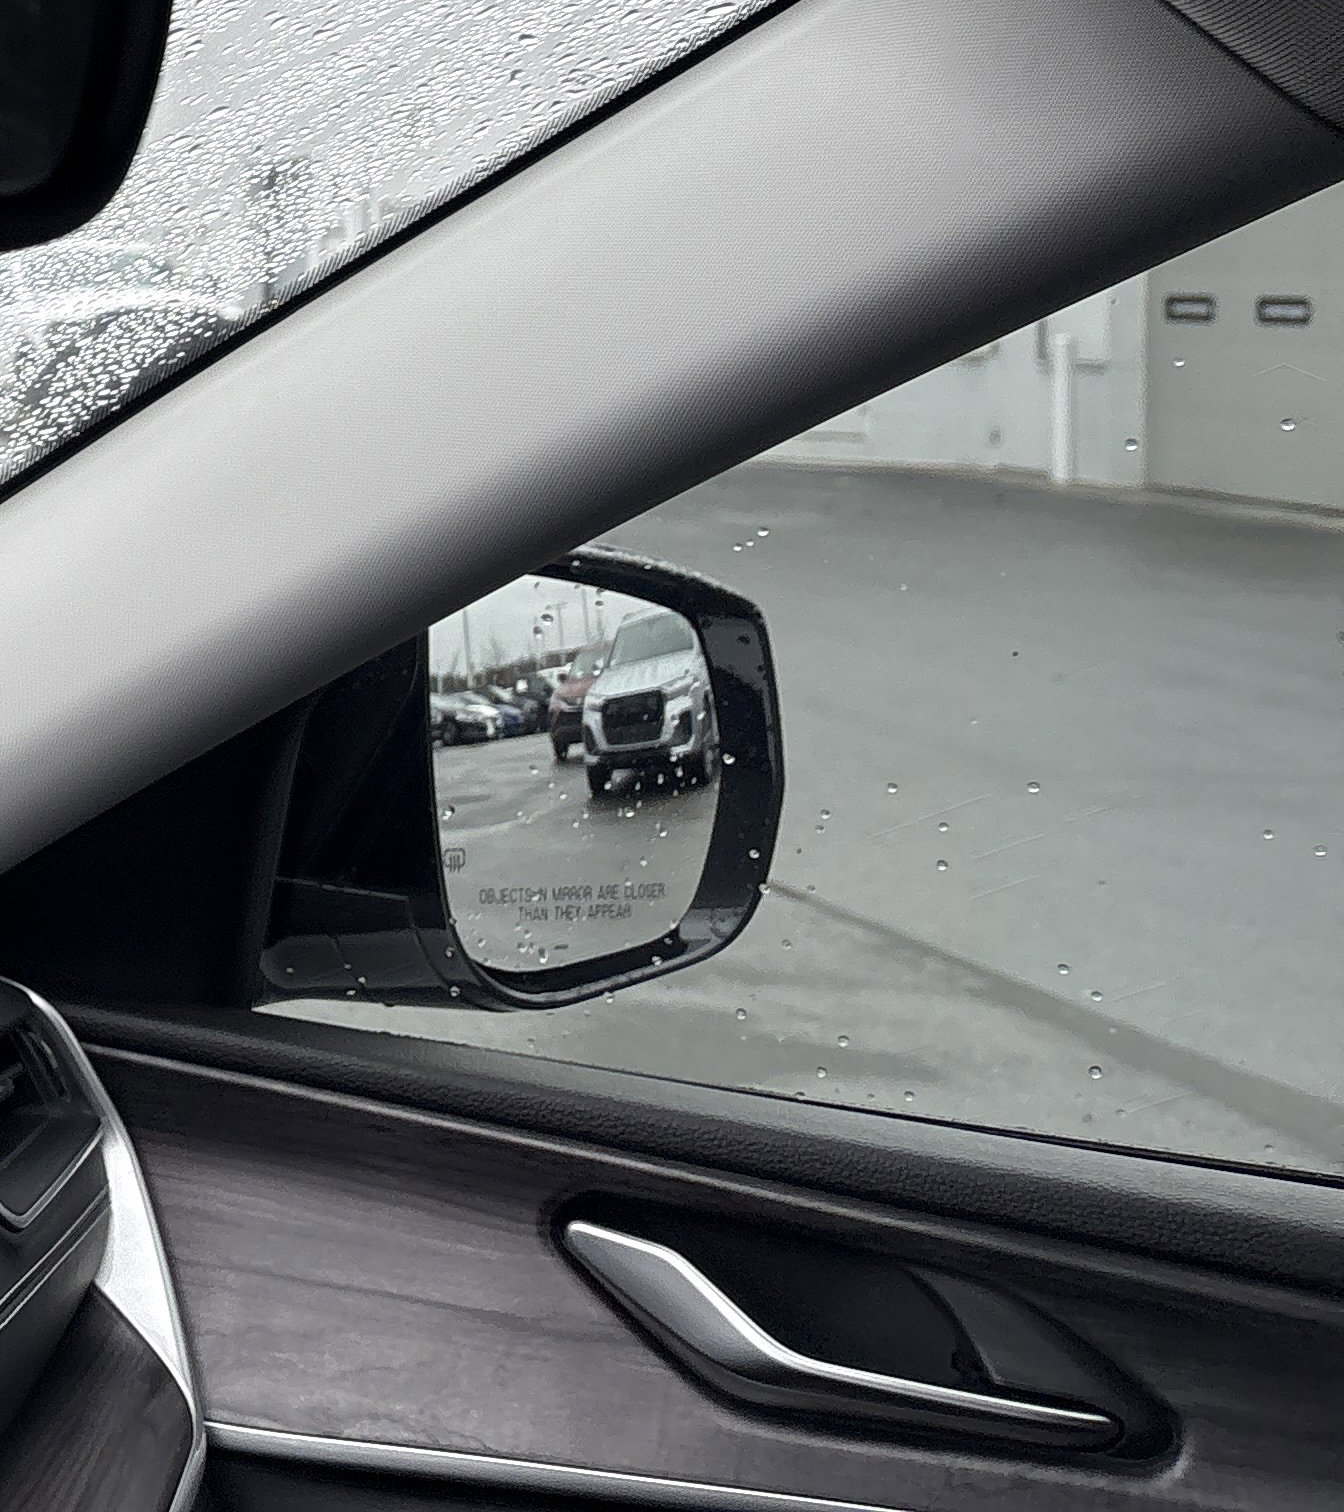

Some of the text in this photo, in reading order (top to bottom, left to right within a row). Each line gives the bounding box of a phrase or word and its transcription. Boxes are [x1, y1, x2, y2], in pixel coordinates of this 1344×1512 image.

[479, 887, 532, 905] OBJECTS
[552, 885, 593, 902] MIRROR
[597, 884, 620, 901] ARE
[624, 883, 667, 901] CLOSER
[518, 902, 633, 921] THAN THEY APPEAR
